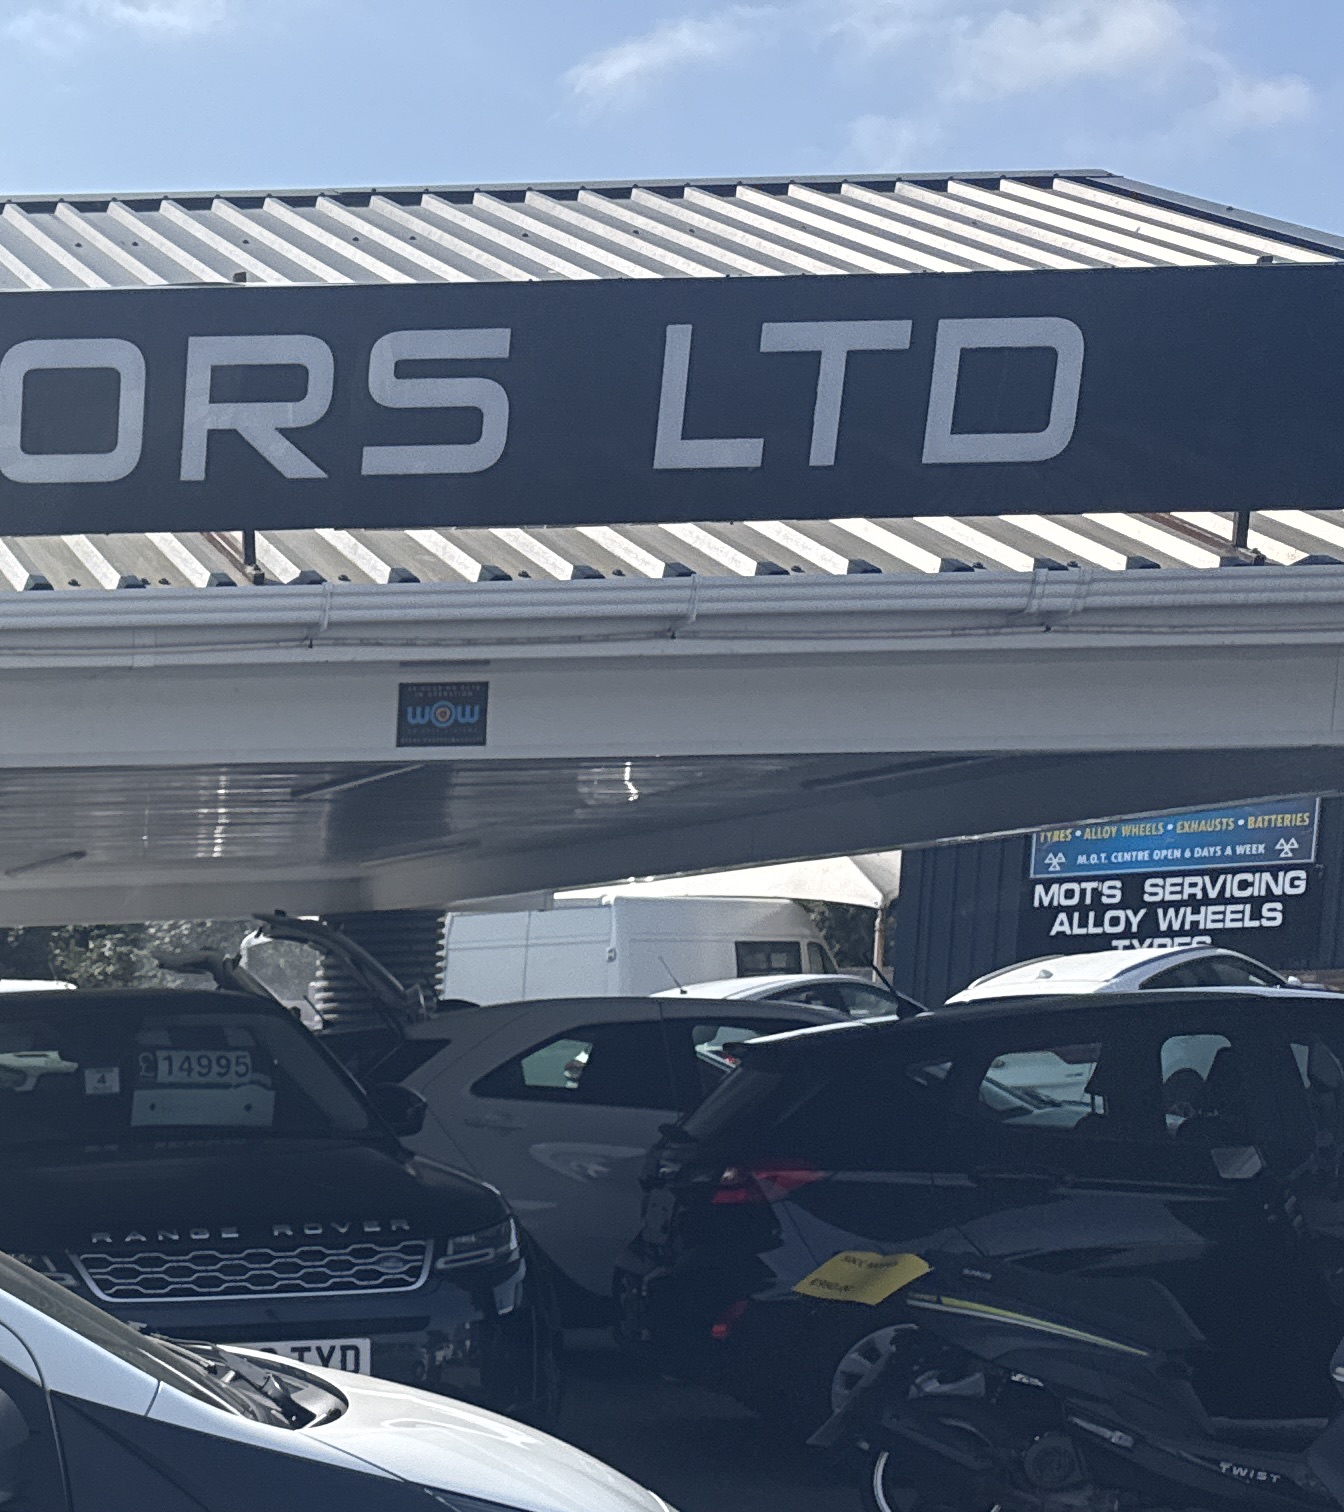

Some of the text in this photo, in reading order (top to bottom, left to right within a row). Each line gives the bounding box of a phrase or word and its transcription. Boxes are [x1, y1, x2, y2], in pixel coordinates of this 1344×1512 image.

[653, 316, 1084, 470] LTD
[1039, 812, 1310, 843] TYRES ALLOY WHEELS EXHAUSTS BATTERIES
[1076, 843, 1265, 865] M.O.T. CENTRE OPEN 6 DAYS A WEEK
[1033, 869, 1308, 908] MOT'S SERVICING
[1049, 902, 1284, 936] ALLOY WHEELS
[91, 1219, 410, 1243] RANGE ROVER
[1219, 1461, 1281, 1483] TWIST
